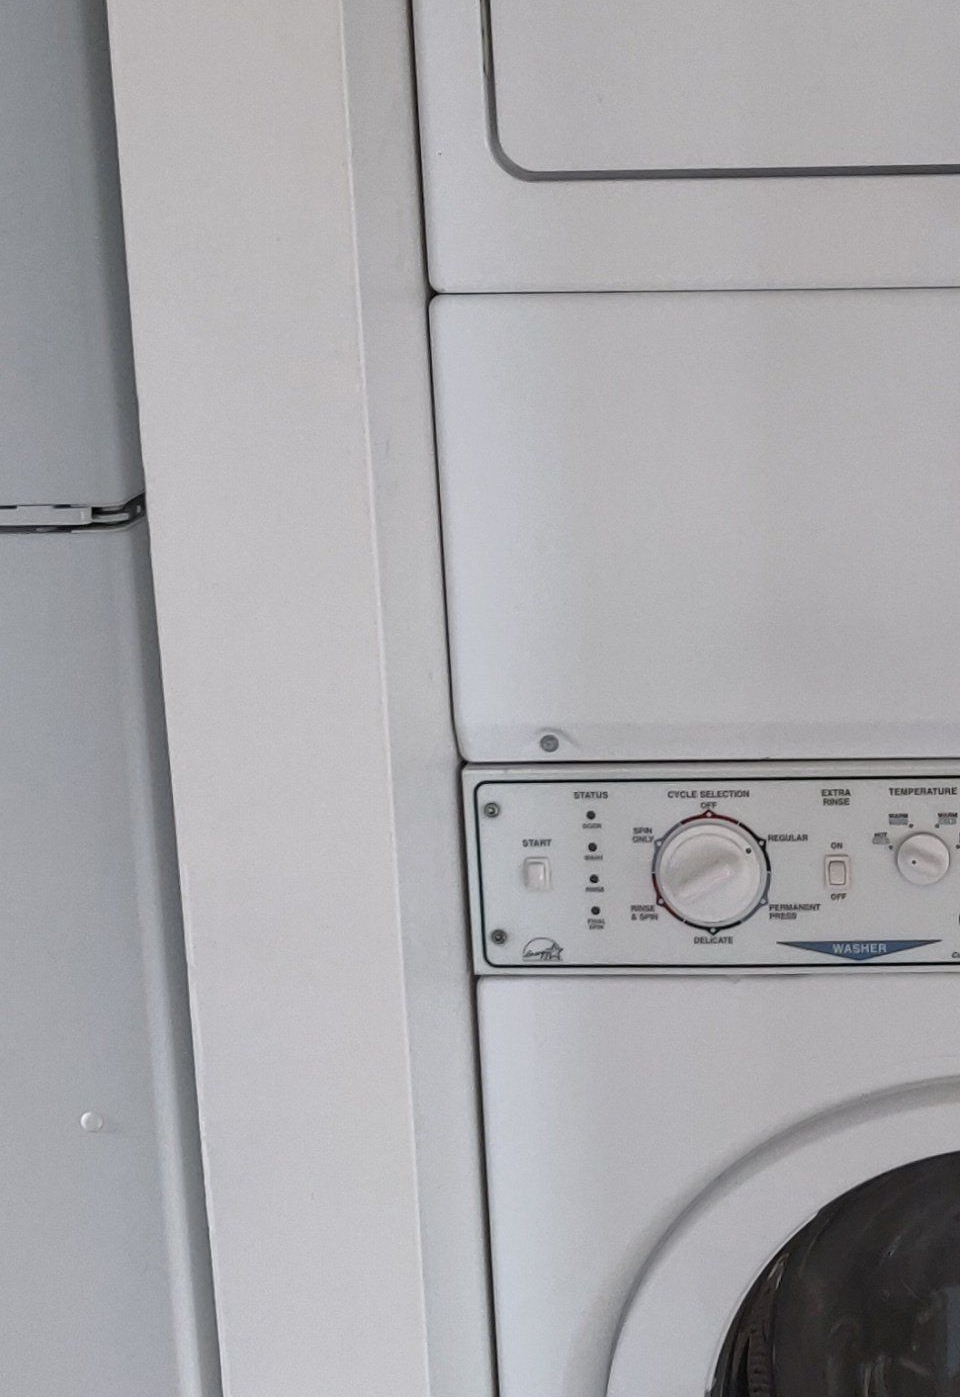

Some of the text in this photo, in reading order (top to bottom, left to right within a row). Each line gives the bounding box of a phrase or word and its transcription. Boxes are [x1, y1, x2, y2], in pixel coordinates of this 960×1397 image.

[573, 791, 609, 800] STATUS
[667, 790, 750, 799] CYCLE SELECTION
[821, 789, 851, 797] EXTRA
[888, 787, 958, 796] TEMPERATURE
[700, 801, 718, 809] OFF
[823, 798, 850, 806] RINSE
[632, 827, 652, 835] SPIN
[632, 835, 654, 843] ONLY
[767, 834, 809, 842] REGULAR
[522, 839, 553, 847] START
[830, 893, 847, 901] OFF
[631, 905, 656, 913] RINSE
[769, 903, 821, 912] PERMANENT
[639, 913, 659, 921] SPIN
[769, 912, 797, 920] PRESS
[693, 936, 734, 945] DELICATE
[832, 943, 887, 954] WASHER
